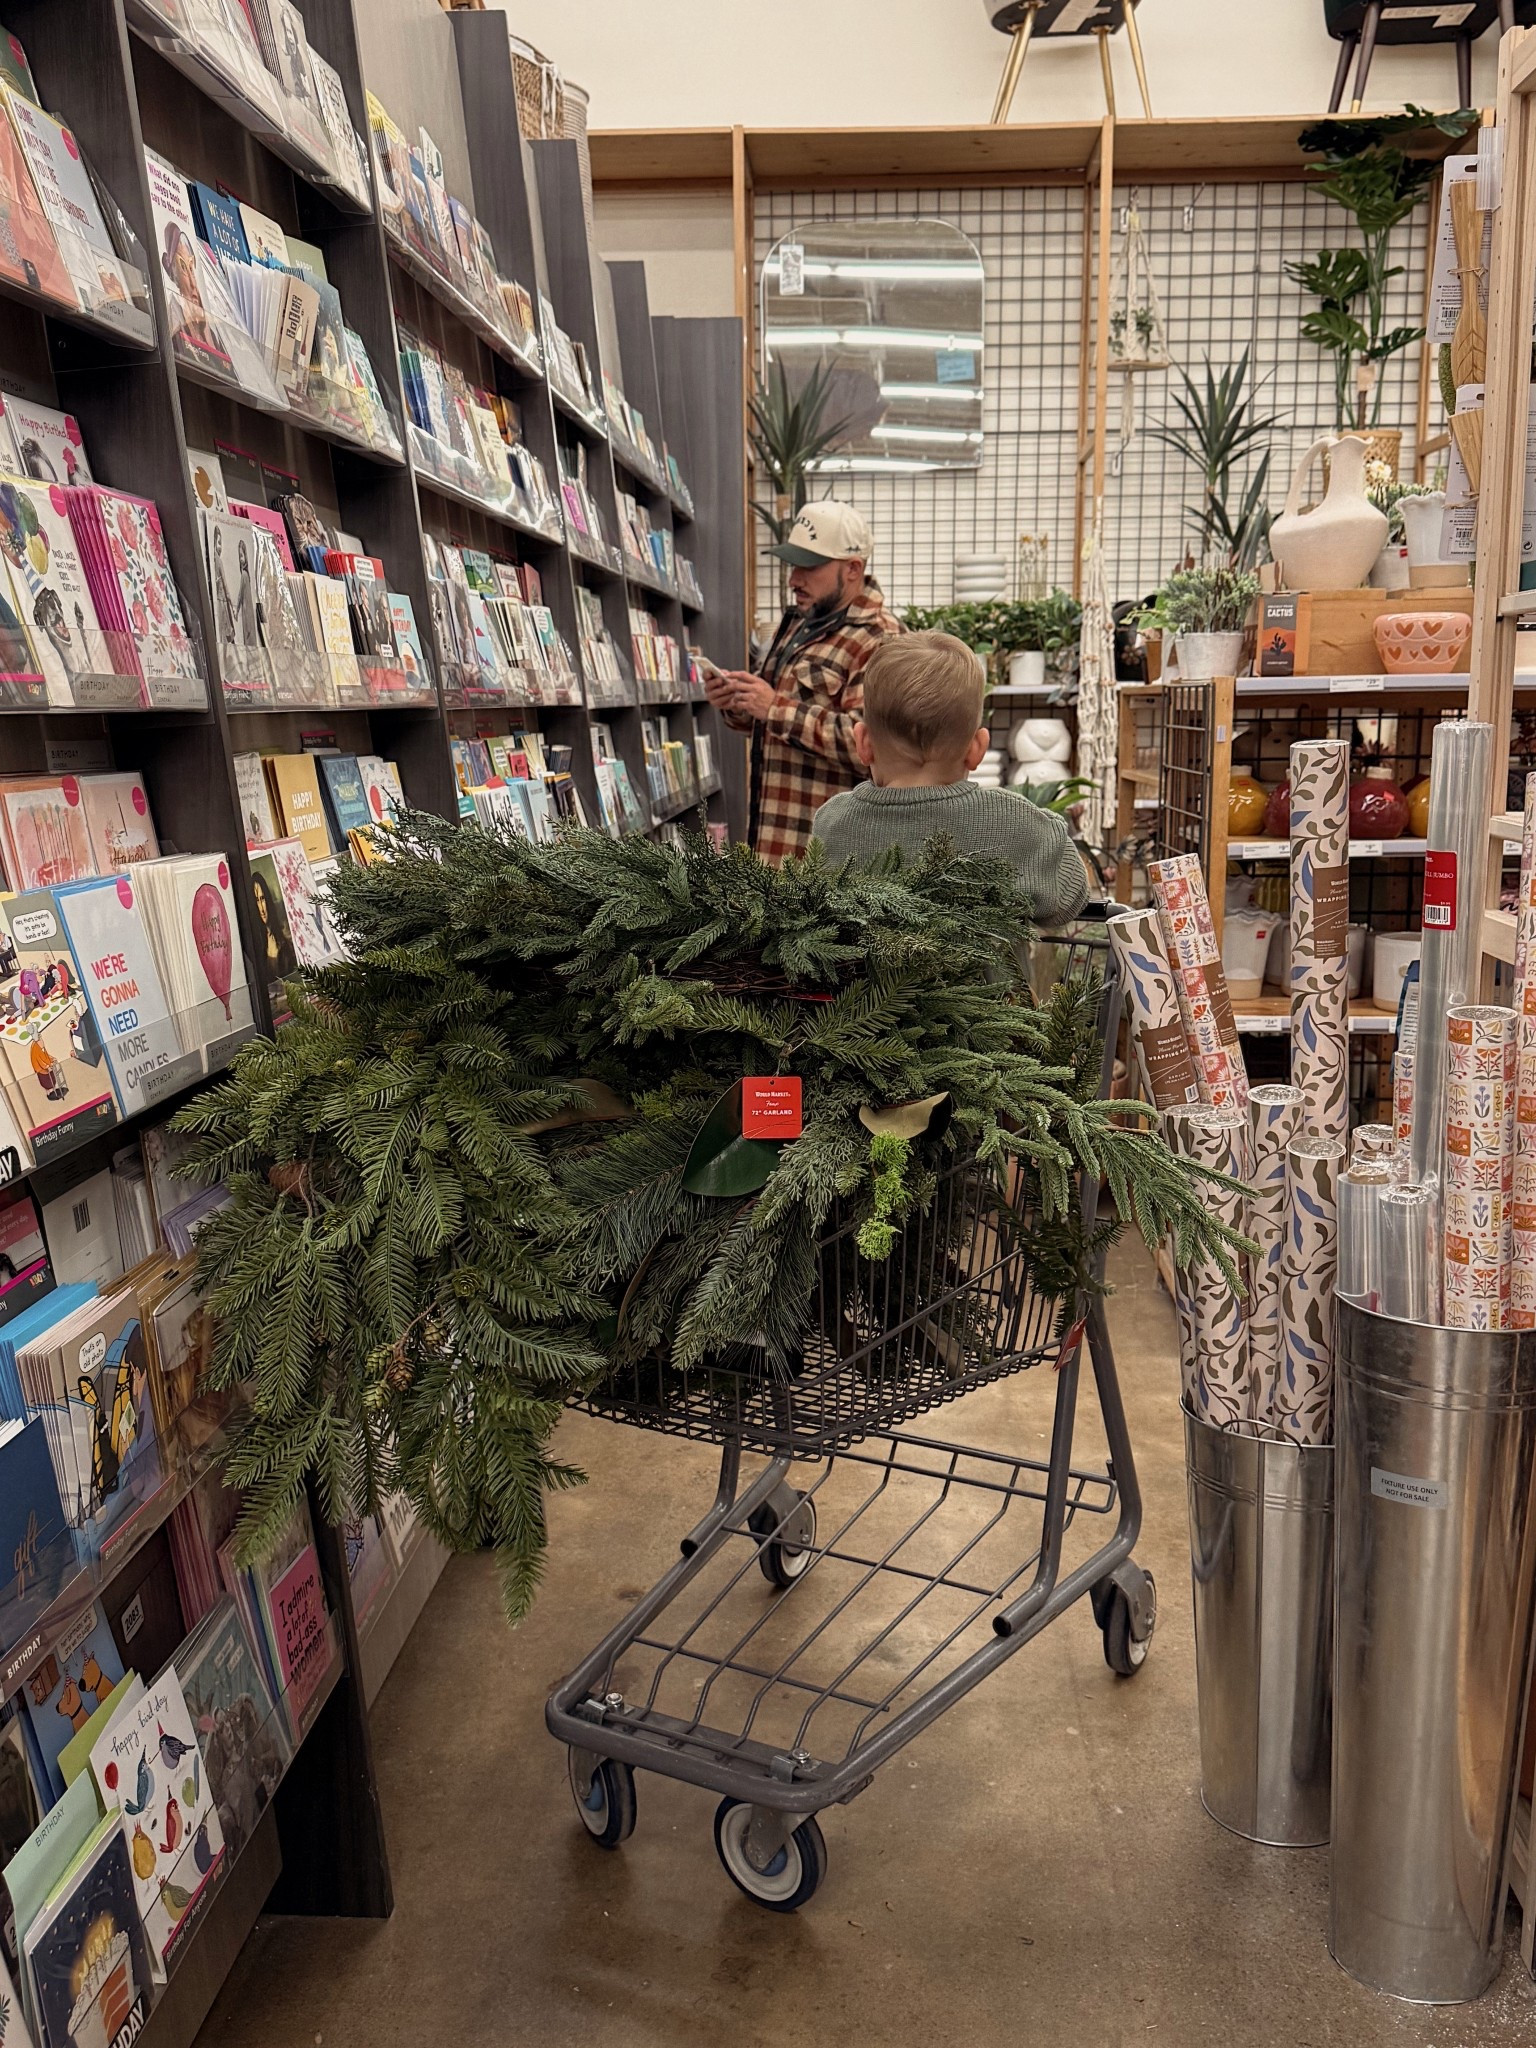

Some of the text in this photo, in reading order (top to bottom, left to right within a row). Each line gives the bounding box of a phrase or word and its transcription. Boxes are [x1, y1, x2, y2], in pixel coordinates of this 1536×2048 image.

[207, 200, 220, 221] WE
[219, 225, 232, 248] LOT
[0, 378, 26, 393] IRTHDAY
[18, 413, 69, 438] Happy Birthd
[1267, 608, 1294, 618] CACTUS
[80, 680, 110, 691] BIRTHDAY
[154, 684, 180, 694] BIRTHDAY
[51, 749, 79, 760] BIRTHDAY
[291, 790, 314, 810] HAPPY
[291, 811, 322, 833] BIRTHDAY
[203, 914, 221, 938] Happy
[200, 939, 228, 957] Birthday
[91, 952, 128, 981] WE'RE
[100, 979, 140, 1008] GONNA
[108, 1008, 139, 1036] NEED
[117, 1033, 149, 1063] MORE
[211, 1042, 233, 1058] BIRTHDAY
[1148, 1051, 1179, 1061] WRAPPING
[147, 1069, 175, 1090] BIRTHDAY
[35, 1120, 74, 1147] Birthday Funny
[82, 1340, 97, 1357] That's
[83, 1358, 92, 1369] old
[1381, 1478, 1405, 1490] FIXTURE
[1420, 1487, 1438, 1495] ONLY
[1386, 1488, 1430, 1502] NOT FOR SALE
[279, 1573, 315, 1628] I admire
[125, 1605, 140, 1631] 2083
[288, 1615, 318, 1666] bad-ass
[7, 1635, 42, 1679] BIRTHDAY
[290, 1628, 325, 1686] women
[111, 1729, 139, 1756] happy
[35, 1806, 66, 1848] BIRTHDAY
